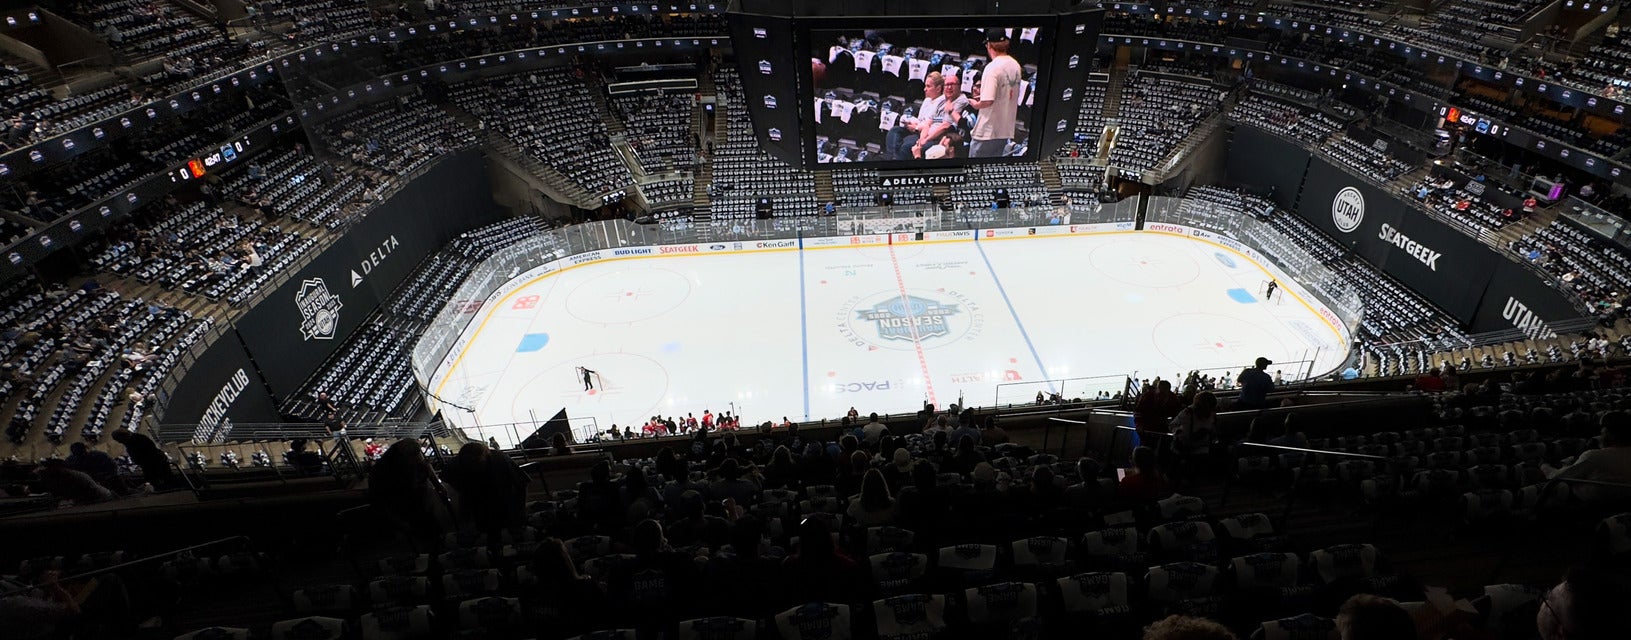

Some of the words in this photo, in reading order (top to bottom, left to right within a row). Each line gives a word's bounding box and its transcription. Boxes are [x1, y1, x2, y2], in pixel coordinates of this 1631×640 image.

[928, 176, 964, 184] CENTER
[1336, 199, 1360, 222] UTAH
[1150, 224, 1183, 234] entrata
[361, 234, 399, 275] DELTA
[570, 252, 600, 260] AMERICAN
[660, 245, 698, 254] SEATGEEK
[1378, 223, 1442, 272] SEATGEEK
[574, 256, 602, 264] EXPRESS
[300, 286, 325, 309] INAUGURAL
[304, 292, 330, 320] SEASON
[880, 315, 944, 328] SEASON
[1320, 307, 1342, 332] entrata
[1502, 296, 1543, 340] UTAH
